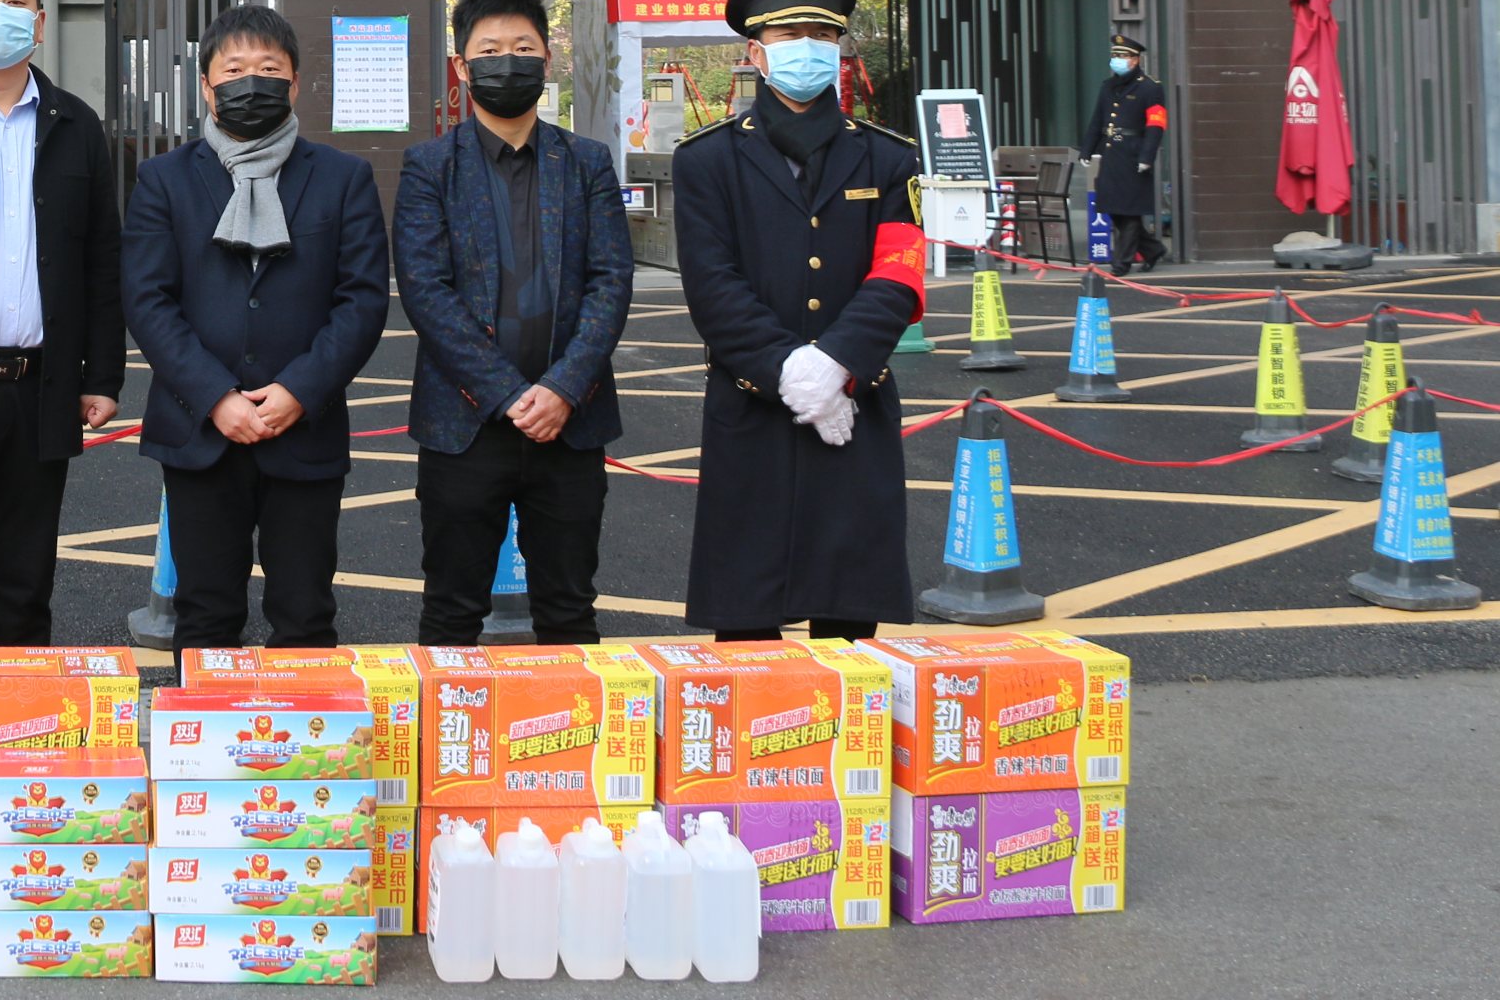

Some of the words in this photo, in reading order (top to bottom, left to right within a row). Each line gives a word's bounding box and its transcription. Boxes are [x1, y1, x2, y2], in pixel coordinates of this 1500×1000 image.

[1270, 328, 1285, 400] 三星智能锁
[174, 723, 199, 739] 双汇
[180, 794, 204, 810] 双汇
[171, 862, 196, 878] 双汇
[178, 928, 202, 943] 双汇
